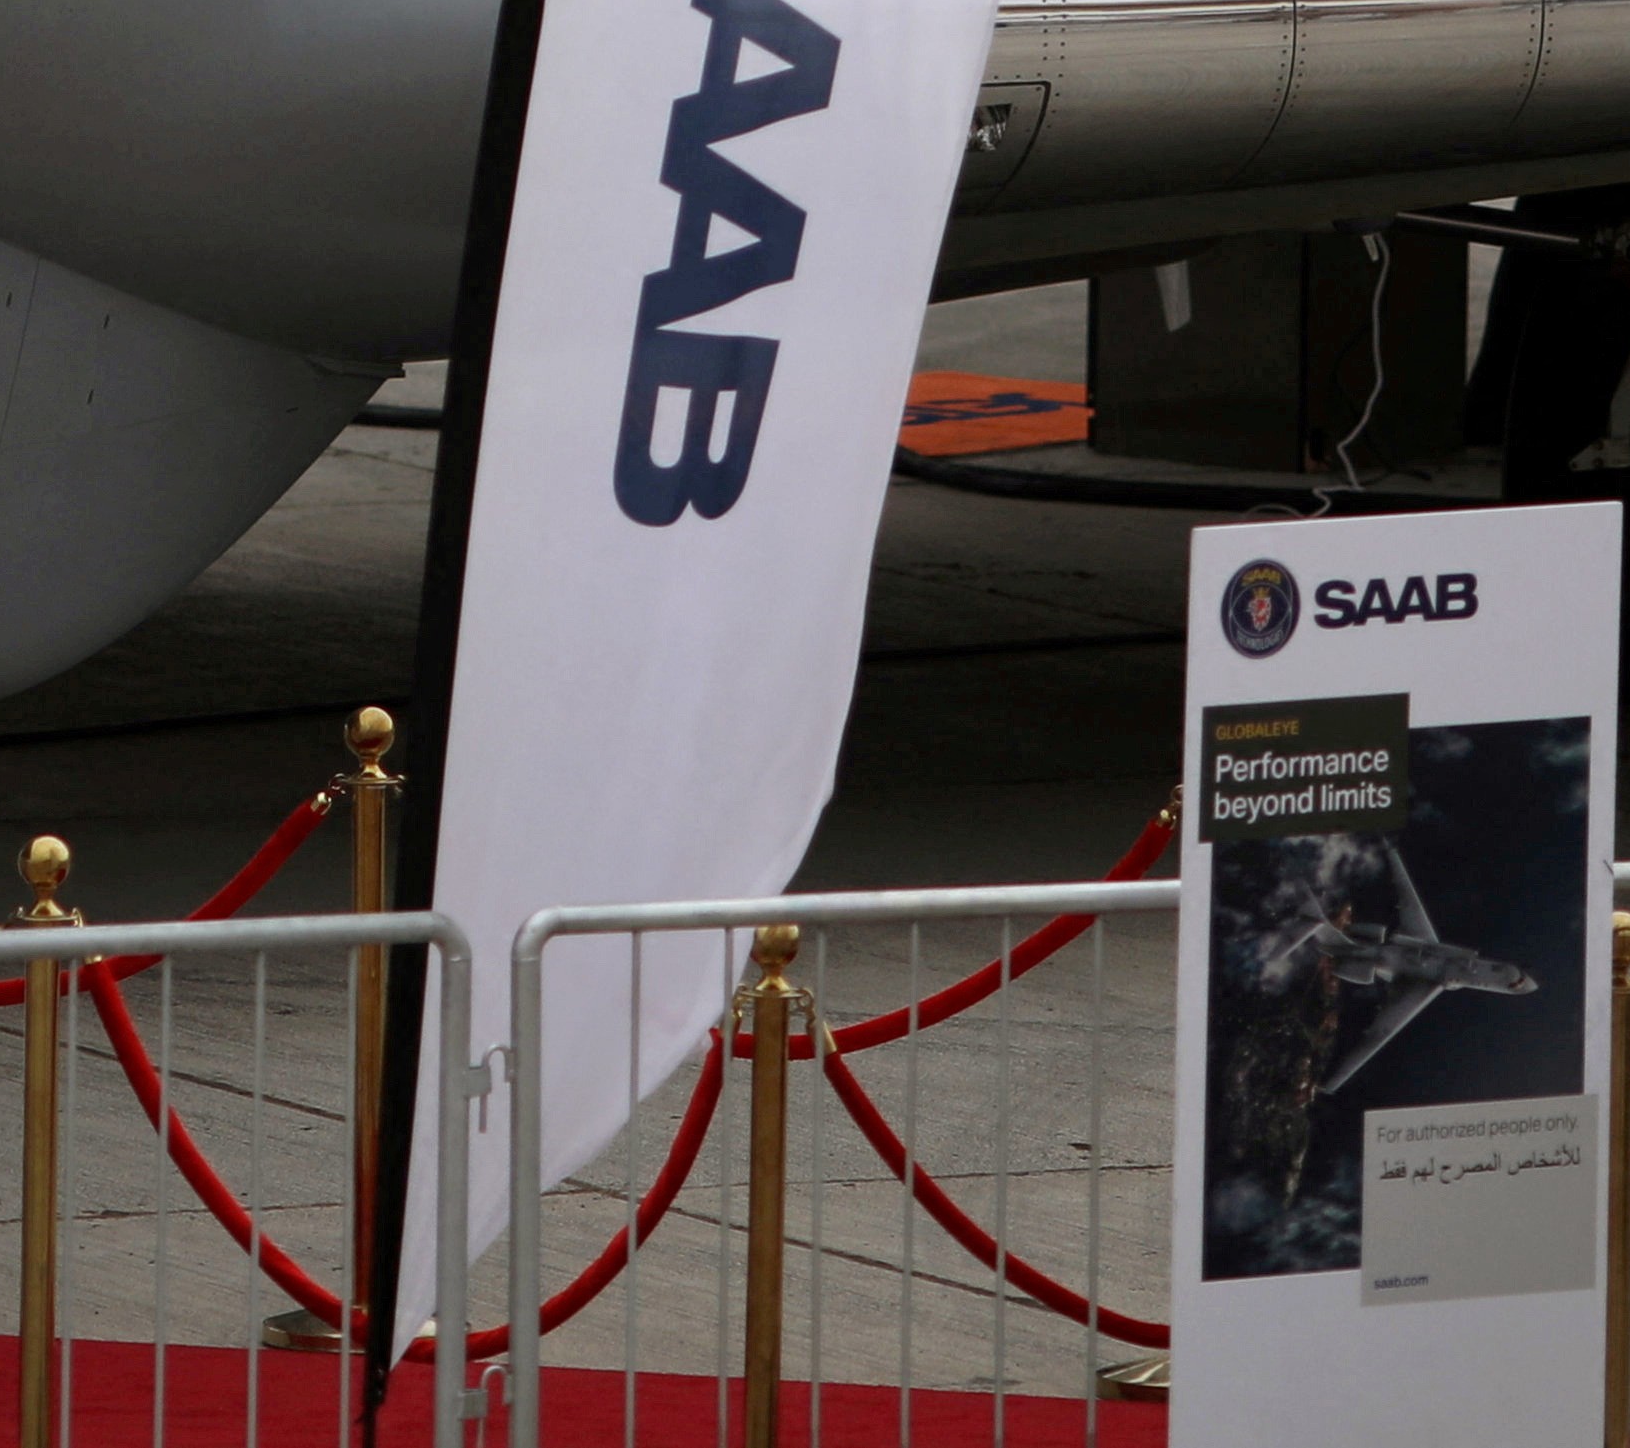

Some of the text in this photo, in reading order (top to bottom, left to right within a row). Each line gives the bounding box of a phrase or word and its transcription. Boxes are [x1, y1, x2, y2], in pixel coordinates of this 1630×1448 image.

[1314, 571, 1480, 630] SAAB
[1215, 719, 1300, 741] GLOBALEYE
[1215, 748, 1390, 783] Performance
[1213, 781, 1393, 825] beyond limits
[1377, 1114, 1580, 1144] For authorized people only.
[1379, 1143, 1581, 1187] للأشخاص المصرح لهم فقط
[1373, 1274, 1429, 1291] saab.com
